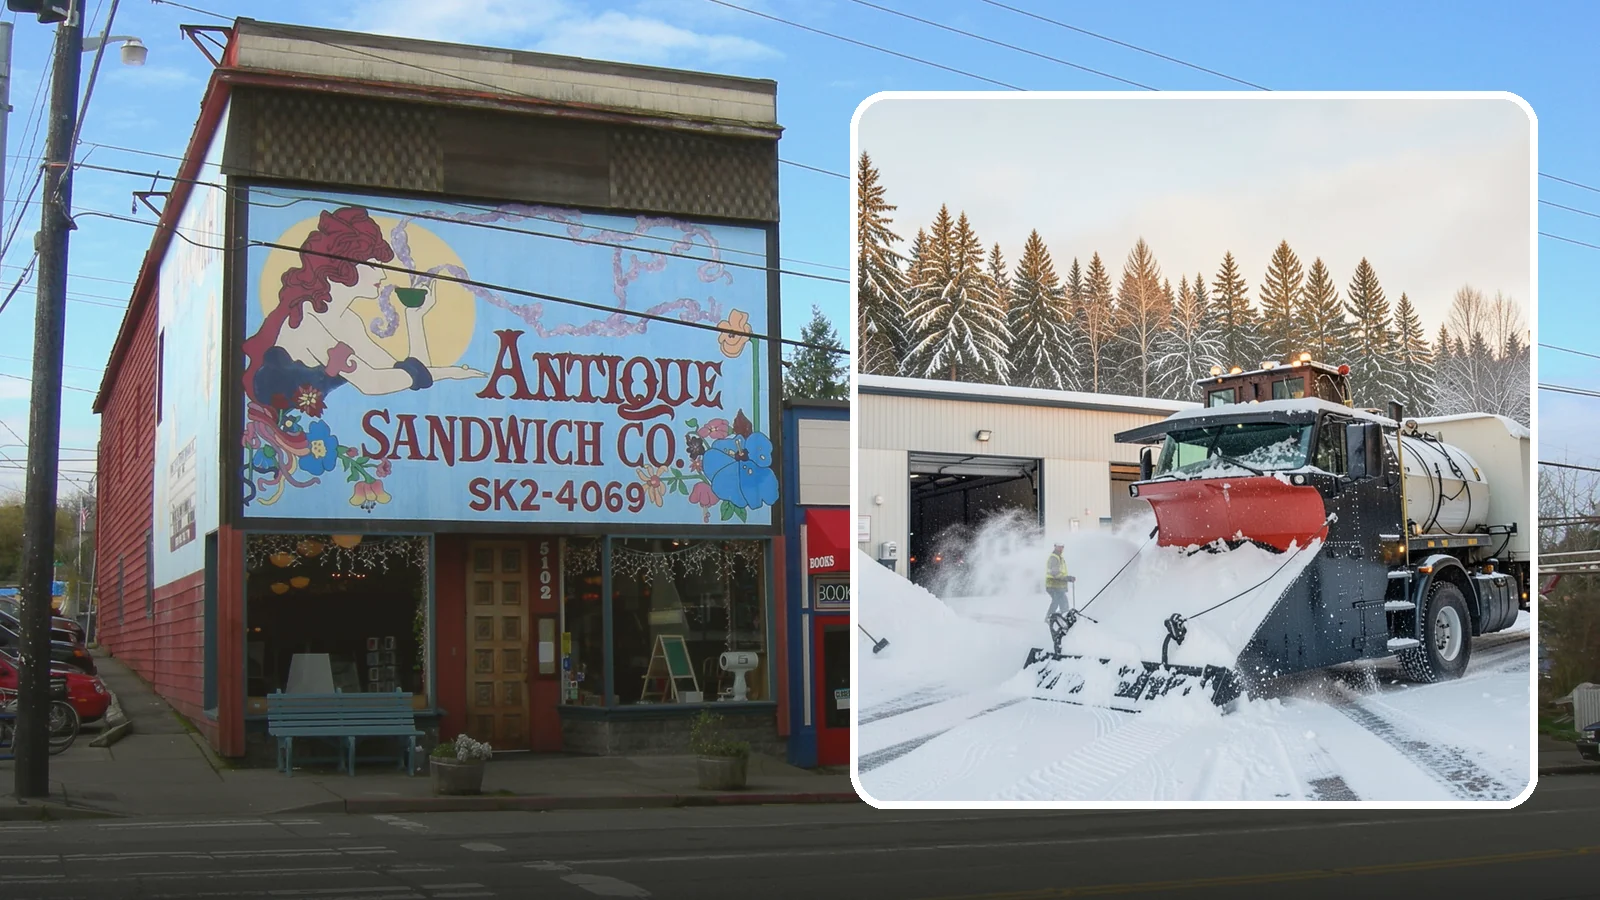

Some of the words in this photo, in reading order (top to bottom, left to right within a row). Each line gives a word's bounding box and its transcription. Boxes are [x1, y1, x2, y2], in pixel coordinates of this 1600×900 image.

[475, 329, 724, 421] ANTIQUE
[361, 408, 605, 468] SANDWICH
[617, 421, 685, 469] CO.
[468, 477, 646, 513] SK2-4069
[540, 541, 551, 600] 5102
[809, 555, 835, 569] BOOKS
